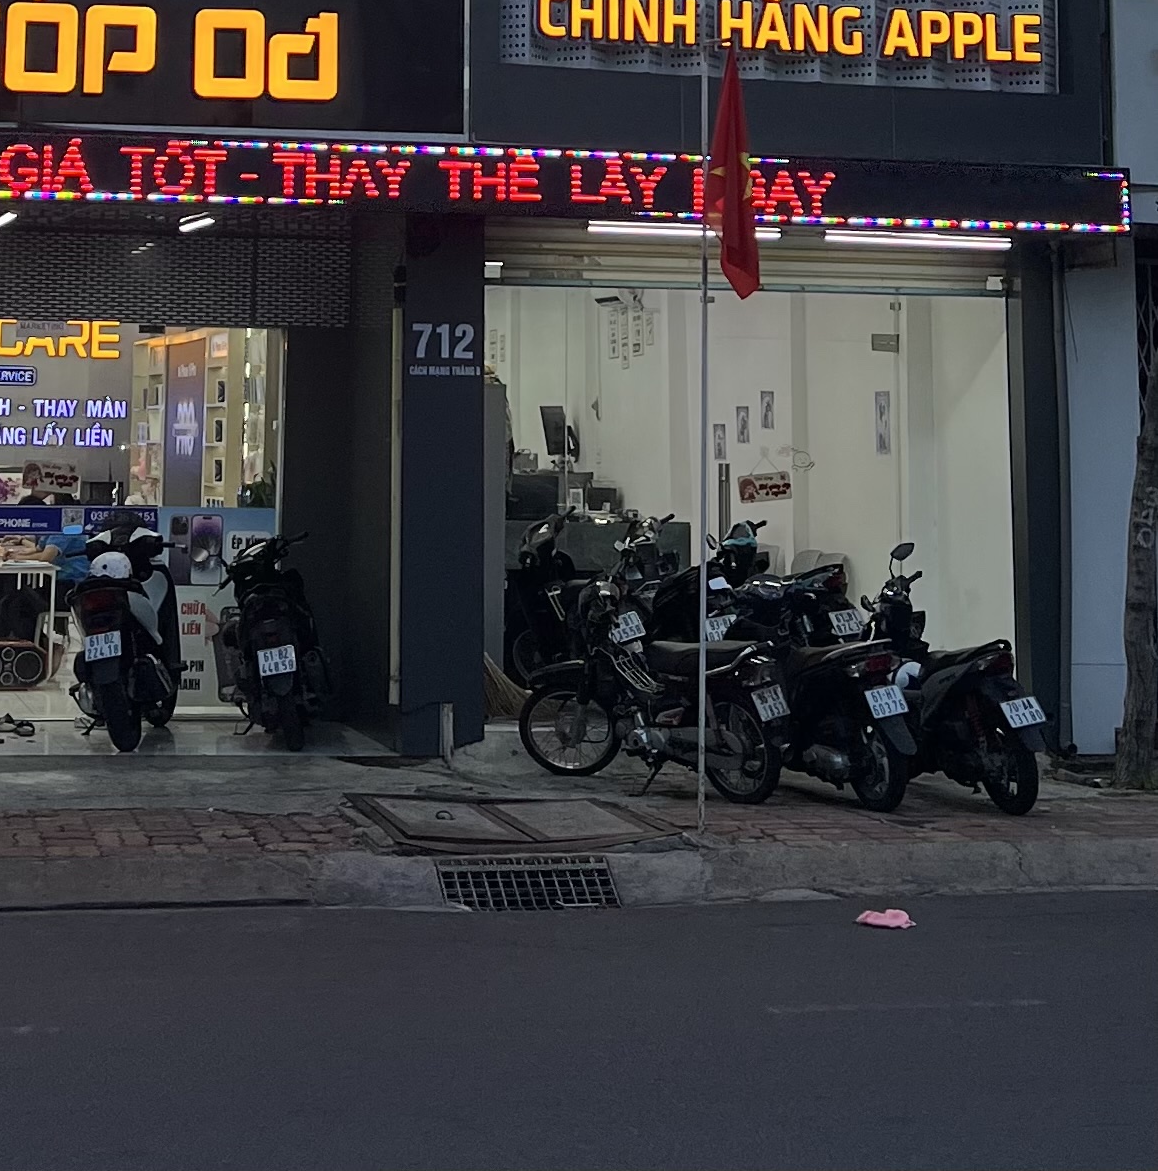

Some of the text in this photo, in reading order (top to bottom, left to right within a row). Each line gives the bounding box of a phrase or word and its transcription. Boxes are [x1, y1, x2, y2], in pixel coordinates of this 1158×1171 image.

[883, 8, 1042, 63] APPLE
[272, 153, 411, 199] THAY
[412, 323, 474, 359] 712
[33, 399, 78, 418] THAY
[86, 396, 127, 418] MÀN
[190, 660, 204, 672] PIN
